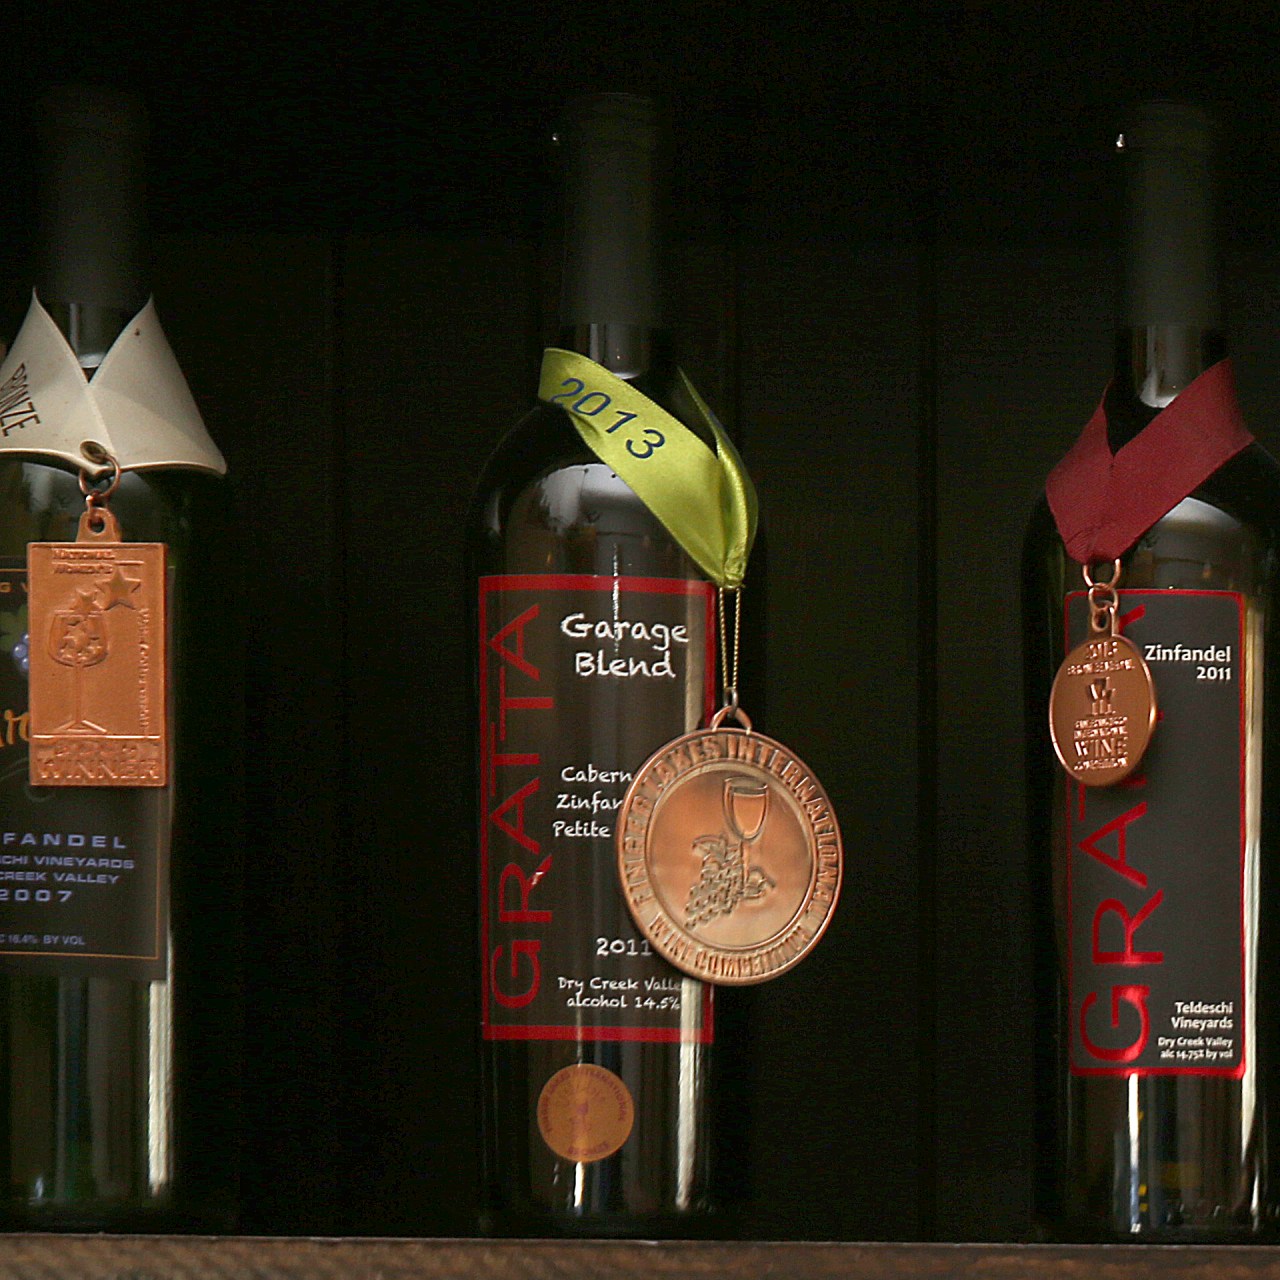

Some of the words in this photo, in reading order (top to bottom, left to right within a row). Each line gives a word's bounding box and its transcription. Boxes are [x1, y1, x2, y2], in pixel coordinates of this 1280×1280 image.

[551, 377, 666, 460] 2013
[561, 613, 690, 651] Garage
[1144, 643, 1232, 664] Zinfandel
[575, 650, 676, 678] Blend
[1196, 666, 1232, 681] 2011
[561, 764, 633, 783] Cabern
[488, 604, 554, 1009] GRATTA
[552, 820, 611, 838] Petite
[34, 856, 135, 869] VINEYARDS
[53, 873, 120, 884] VALLEY
[0, 889, 73, 903] 2007
[43, 935, 59, 944] BY
[62, 935, 86, 946] VOL
[596, 937, 653, 957] 2011
[558, 976, 584, 995] Dry
[590, 976, 639, 990] Creek
[566, 993, 628, 1008] alcohol
[1174, 1001, 1234, 1014] Teldeschi
[1171, 1016, 1234, 1031] Vineyards
[1158, 1036, 1176, 1048] Dry
[1177, 1036, 1205, 1046] Creek
[1206, 1036, 1234, 1049] Valley
[1206, 1049, 1217, 1060] by
[1219, 1049, 1234, 1058] vol
